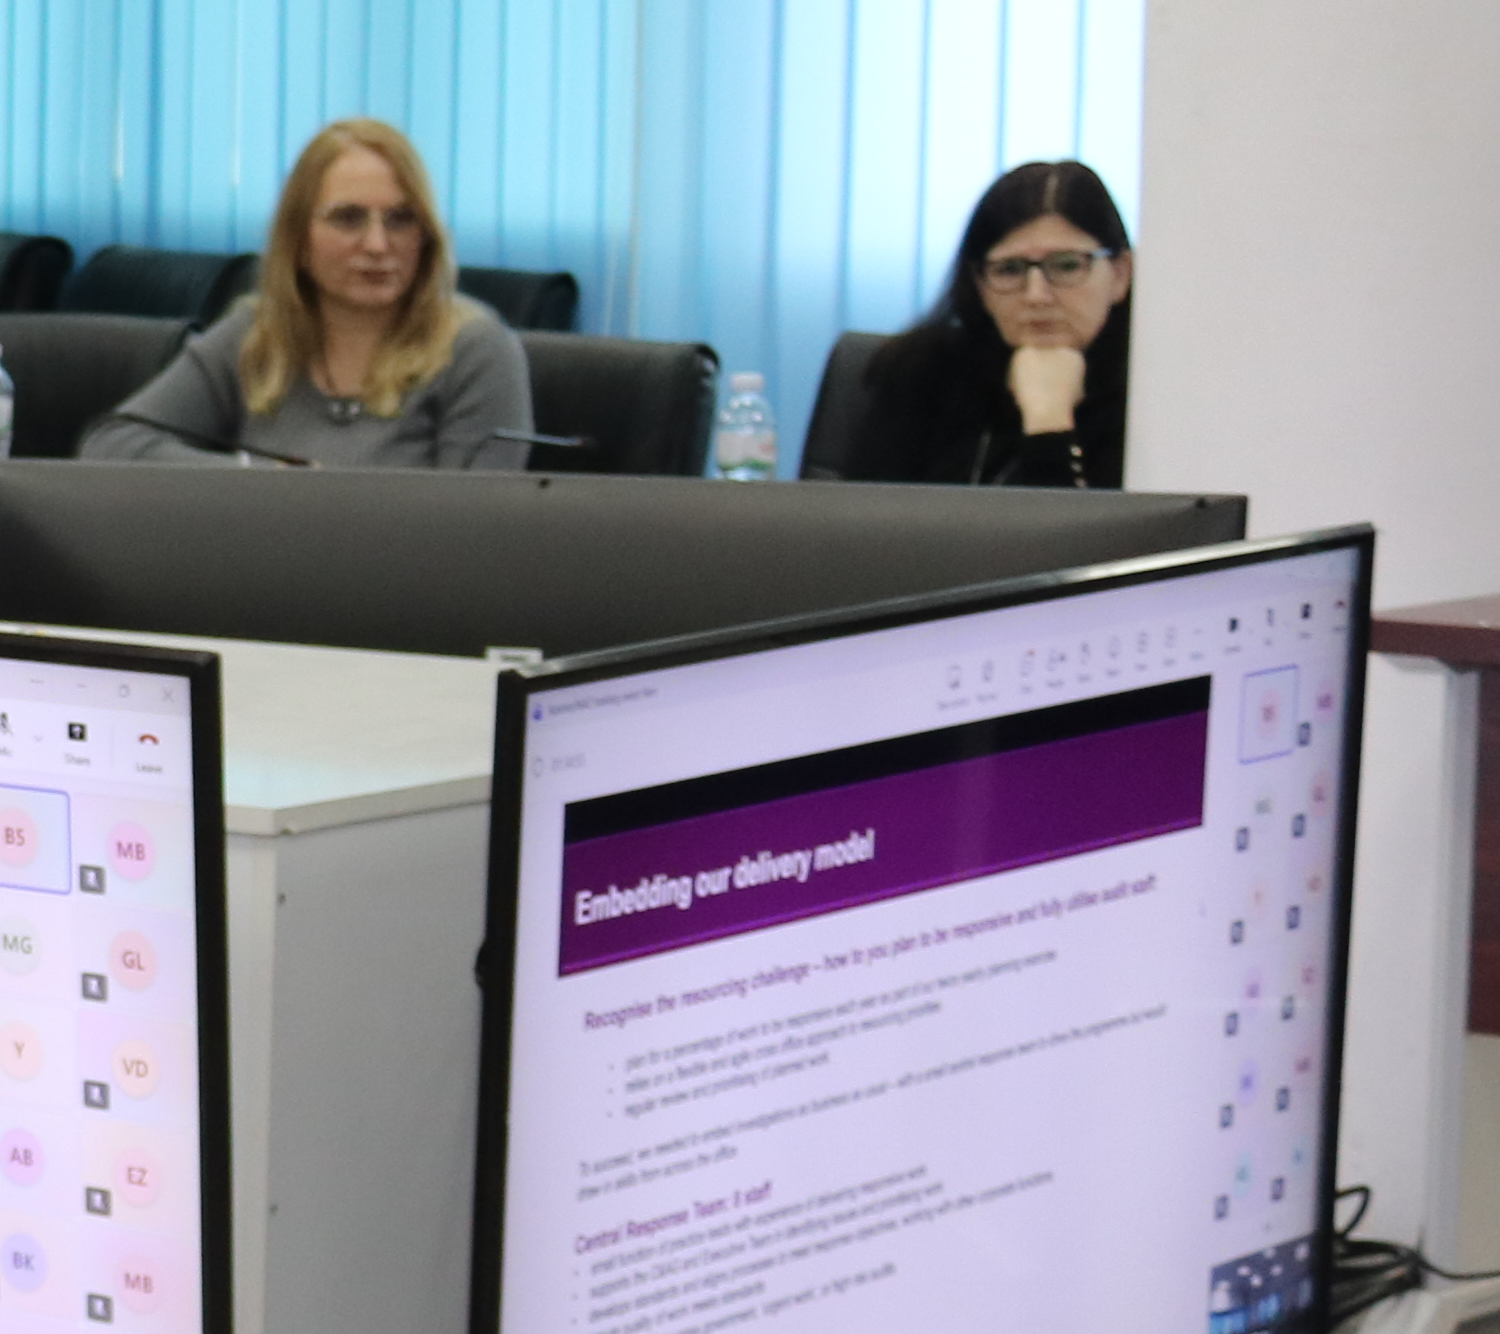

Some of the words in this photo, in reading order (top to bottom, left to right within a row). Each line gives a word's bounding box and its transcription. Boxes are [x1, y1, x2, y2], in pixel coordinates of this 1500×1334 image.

[4, 826, 25, 846] BS
[116, 841, 146, 861] MB
[573, 873, 692, 927] Embedding
[694, 867, 730, 900] our
[732, 850, 811, 892] delivery
[813, 827, 876, 873] model
[1, 933, 33, 955] MG
[121, 950, 144, 970] GL
[584, 999, 653, 1032] Recognise
[14, 1040, 26, 1058] Y
[122, 1057, 149, 1078] VD
[9, 1146, 33, 1167] AB
[127, 1166, 147, 1186] EZ
[12, 1251, 34, 1271] BK
[123, 1271, 153, 1294] MB
